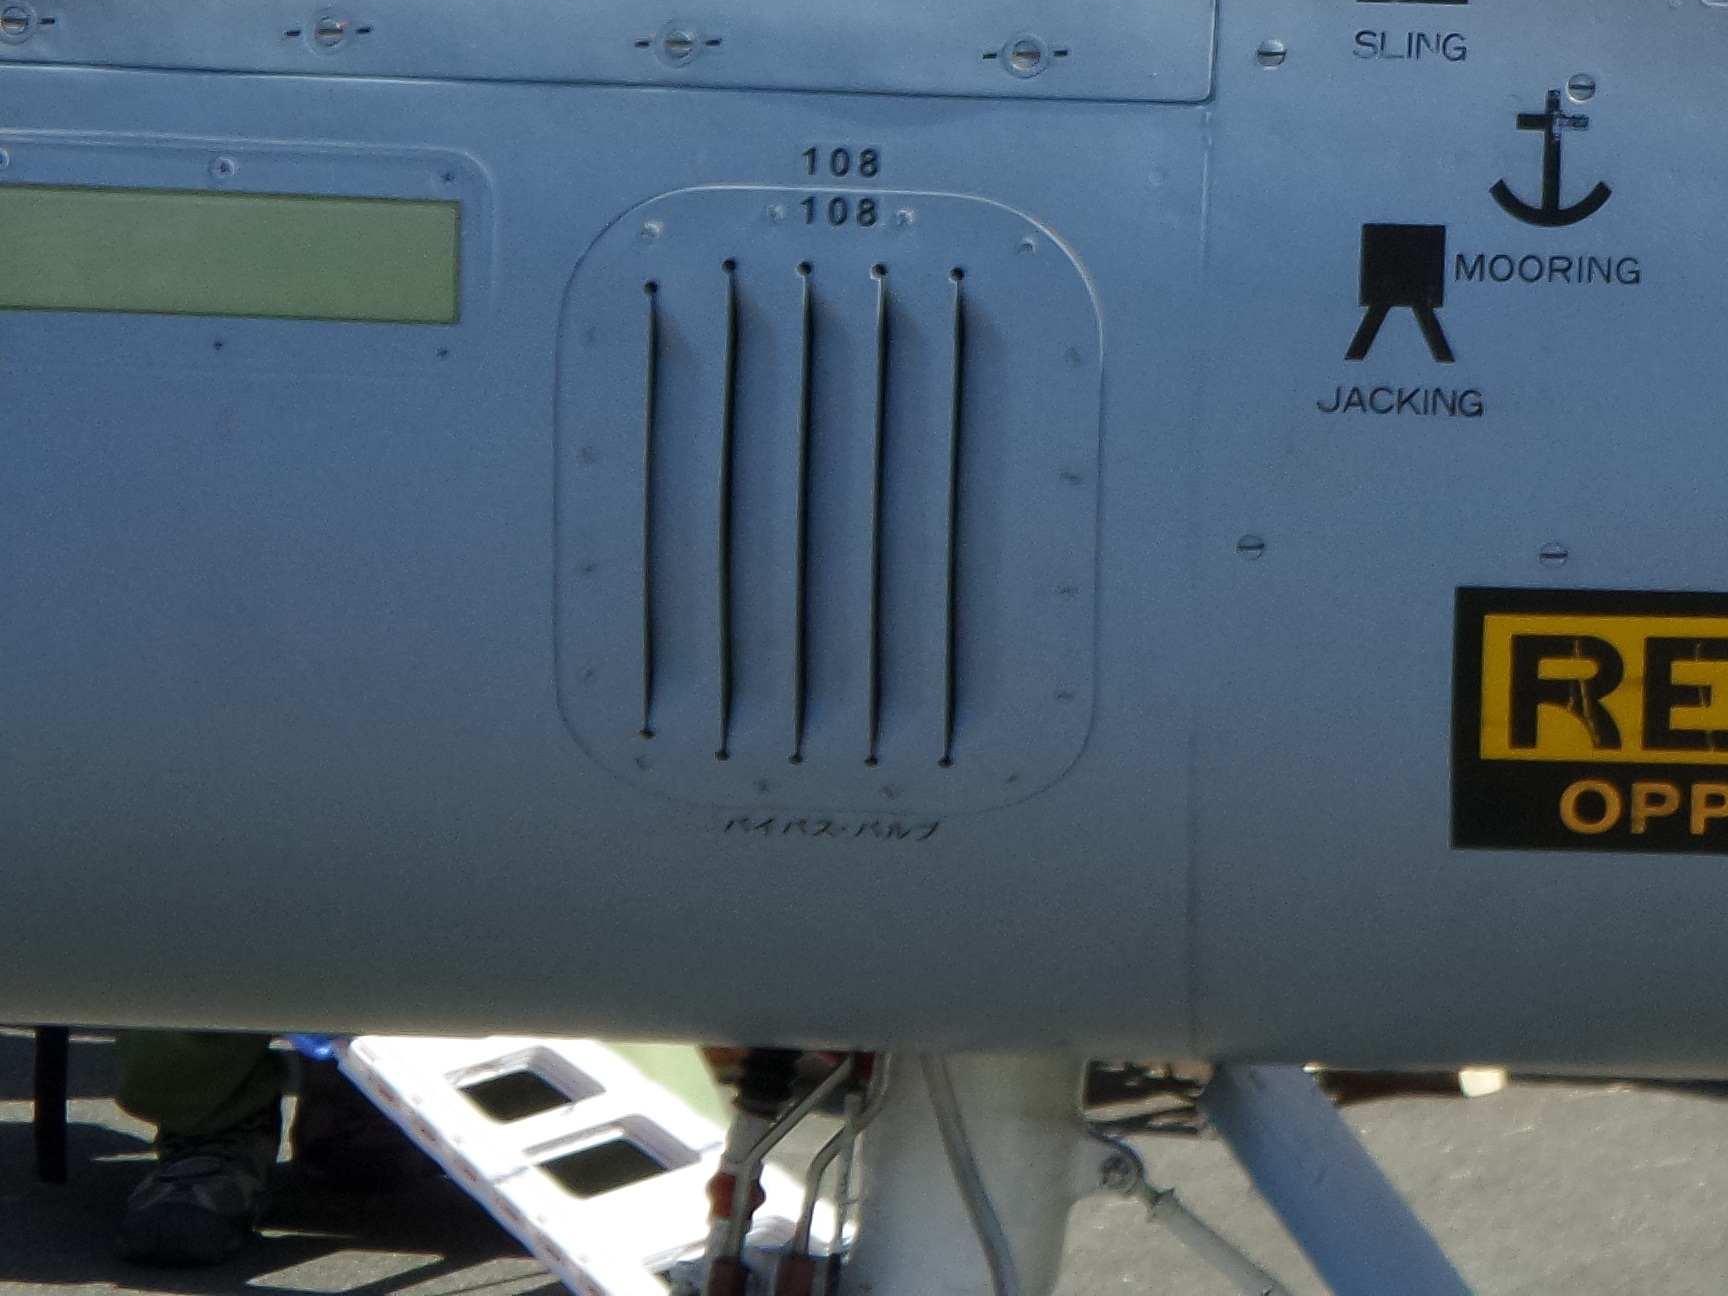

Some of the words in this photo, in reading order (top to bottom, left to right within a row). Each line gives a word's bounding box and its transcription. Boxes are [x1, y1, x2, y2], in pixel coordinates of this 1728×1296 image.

[1352, 29, 1468, 62] SLING
[801, 145, 878, 178] 108
[800, 195, 877, 227] 108
[1453, 252, 1642, 286] MOORING
[1316, 384, 1485, 419] JACKING
